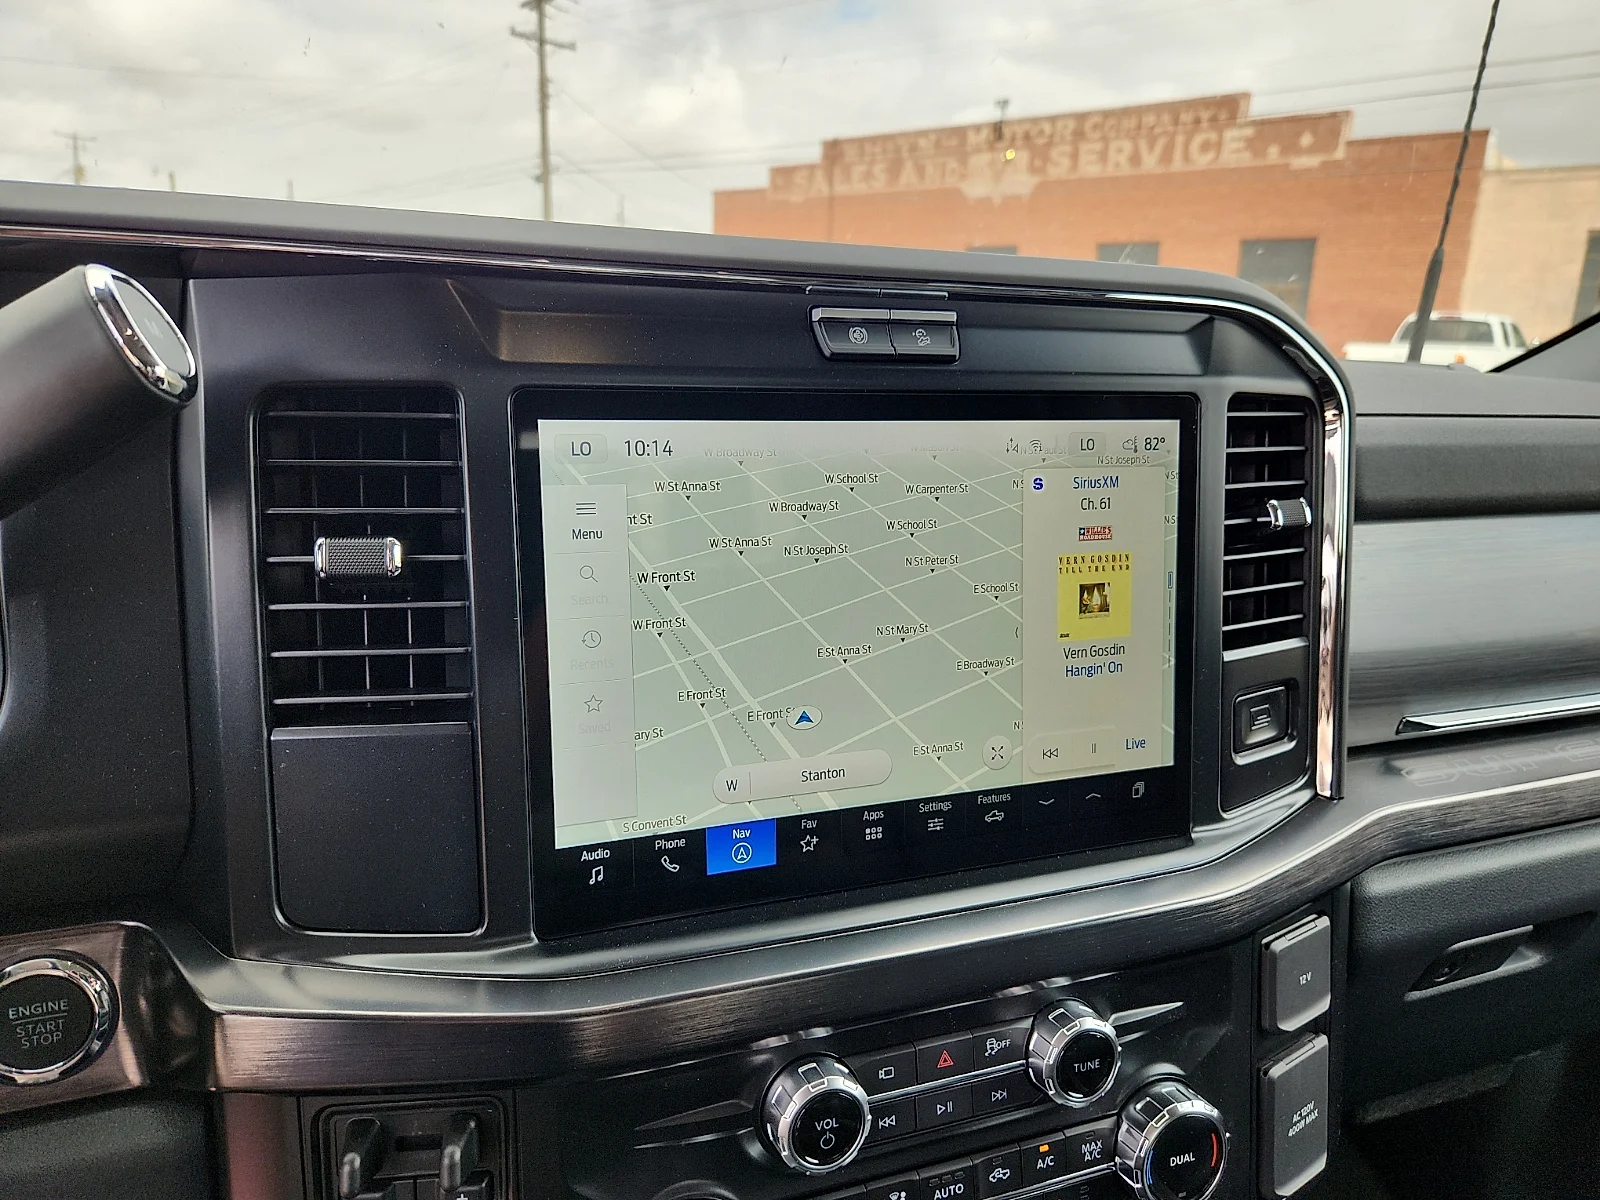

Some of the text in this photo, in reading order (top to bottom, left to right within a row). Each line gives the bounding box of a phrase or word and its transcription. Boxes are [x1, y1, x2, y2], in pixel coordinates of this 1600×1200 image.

[1045, 125, 1256, 179] SERVICE
[571, 441, 592, 456] LO
[624, 440, 673, 456] 10:14
[1080, 438, 1095, 451] LO
[1144, 437, 1166, 451] 82°
[1097, 455, 1150, 466] N St Joseph St
[825, 473, 878, 484] W School St
[1073, 476, 1119, 489] SiriusXM
[655, 481, 721, 492] W St Anna St
[905, 483, 968, 496] W Carpenter St
[769, 501, 839, 514] W Broadway St
[1081, 497, 1111, 511] Ch. 61
[639, 513, 652, 525] St
[886, 519, 937, 530] W School St
[572, 528, 603, 539] Menu
[709, 536, 772, 548] W St Anna St
[784, 544, 848, 557] N St Joseph St
[905, 555, 958, 566] N St Peter St
[1090, 553, 1129, 564] GOSDIN
[637, 570, 695, 583] W Front St
[973, 583, 1019, 593] E School St
[632, 617, 686, 630] W Front St
[876, 624, 928, 637] N St Mary St
[817, 644, 872, 658] E St Anna St
[1063, 643, 1125, 660] Vern Gosdin
[957, 657, 1015, 671] E Broadway St
[1065, 661, 1123, 679] Hangin' On
[678, 688, 726, 701] E Front St
[748, 707, 795, 721] E Front S
[634, 727, 664, 741] ary St
[913, 741, 964, 756] E St Anna St
[1126, 737, 1146, 750] Live
[801, 767, 845, 782] Stanton
[726, 780, 738, 792] W
[978, 792, 1011, 804] Features
[919, 800, 952, 813] Settings
[863, 810, 884, 822] Apps
[623, 815, 687, 833] S Convent St
[801, 819, 818, 829] Fav
[733, 828, 751, 839] Nav
[655, 837, 686, 850] Phone
[581, 848, 611, 862] Audio
[1299, 971, 1312, 985] 12V
[8, 999, 69, 1019] ENGINE
[16, 1020, 65, 1037] START
[21, 1032, 62, 1049] STOP
[996, 1039, 1011, 1050] OFF
[1074, 1058, 1101, 1072] TUNE
[1301, 1101, 1315, 1117] 120V
[1305, 1108, 1318, 1124] MAX
[815, 1117, 839, 1130] VOL
[1082, 1140, 1104, 1154] MAX
[1036, 1155, 1055, 1169] A/C
[1084, 1149, 1102, 1162] A/C
[1170, 1152, 1196, 1167] DUAL
[934, 1184, 964, 1199] AUTO
